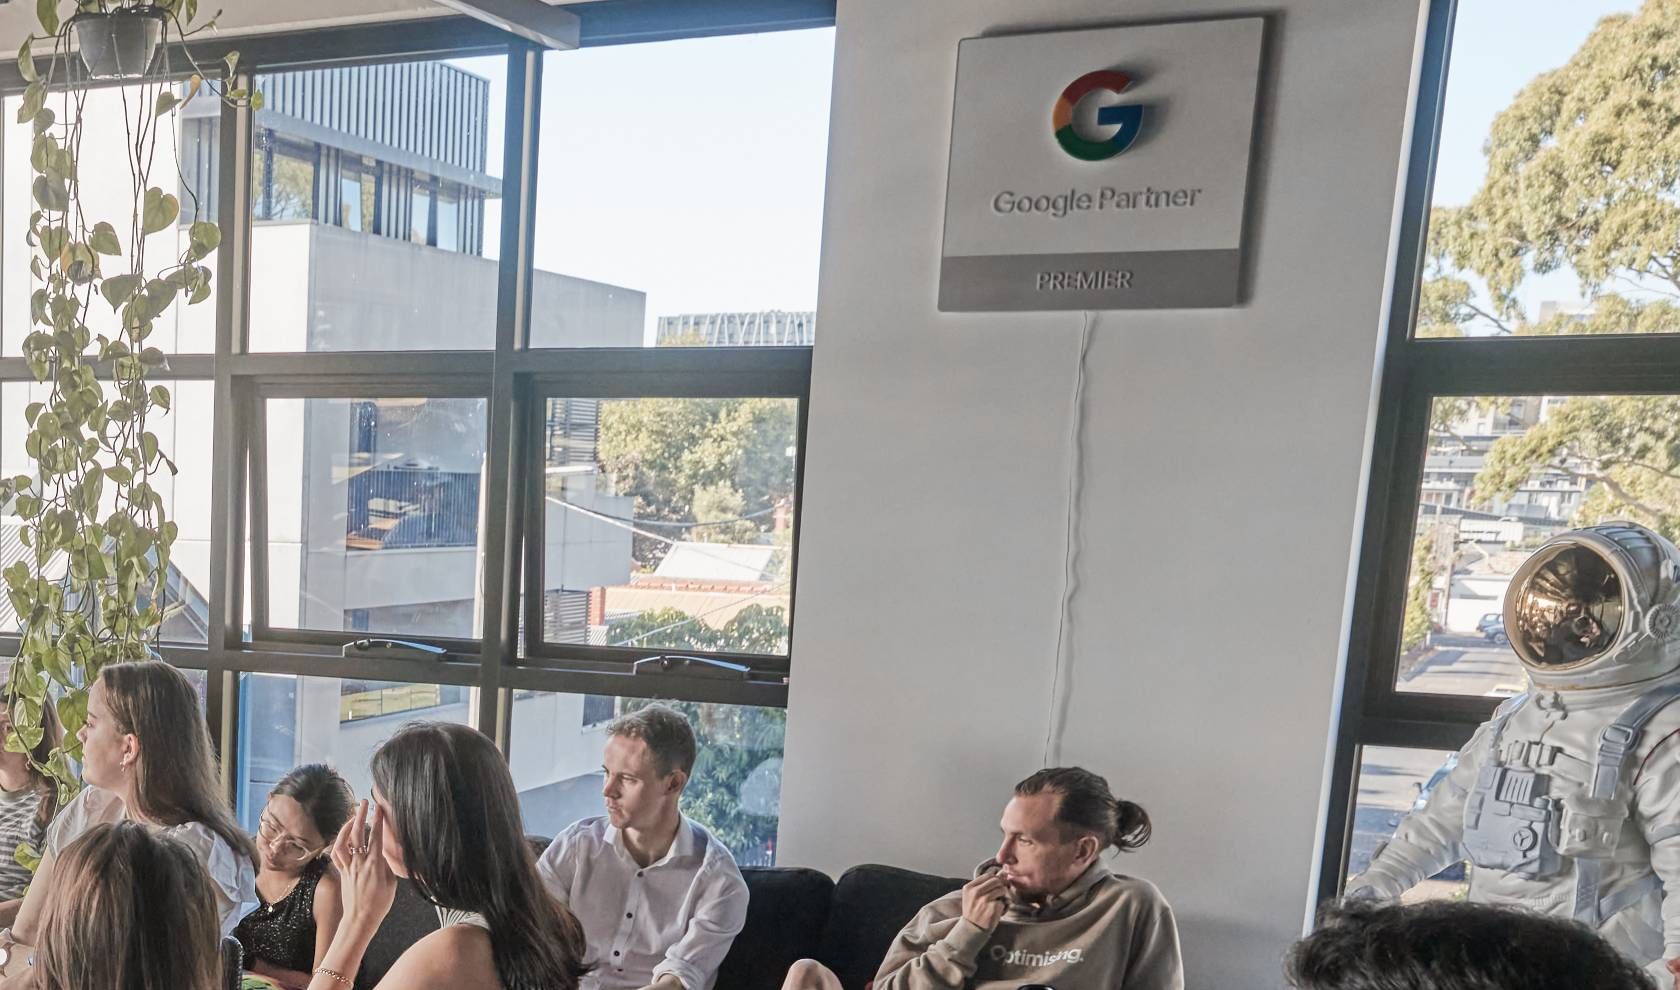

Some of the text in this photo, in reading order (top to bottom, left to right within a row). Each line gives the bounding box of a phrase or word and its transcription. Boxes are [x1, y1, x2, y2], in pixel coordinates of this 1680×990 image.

[1053, 70, 1144, 161] G
[994, 187, 1202, 217] Google Partner
[1036, 271, 1133, 290] PREMIER
